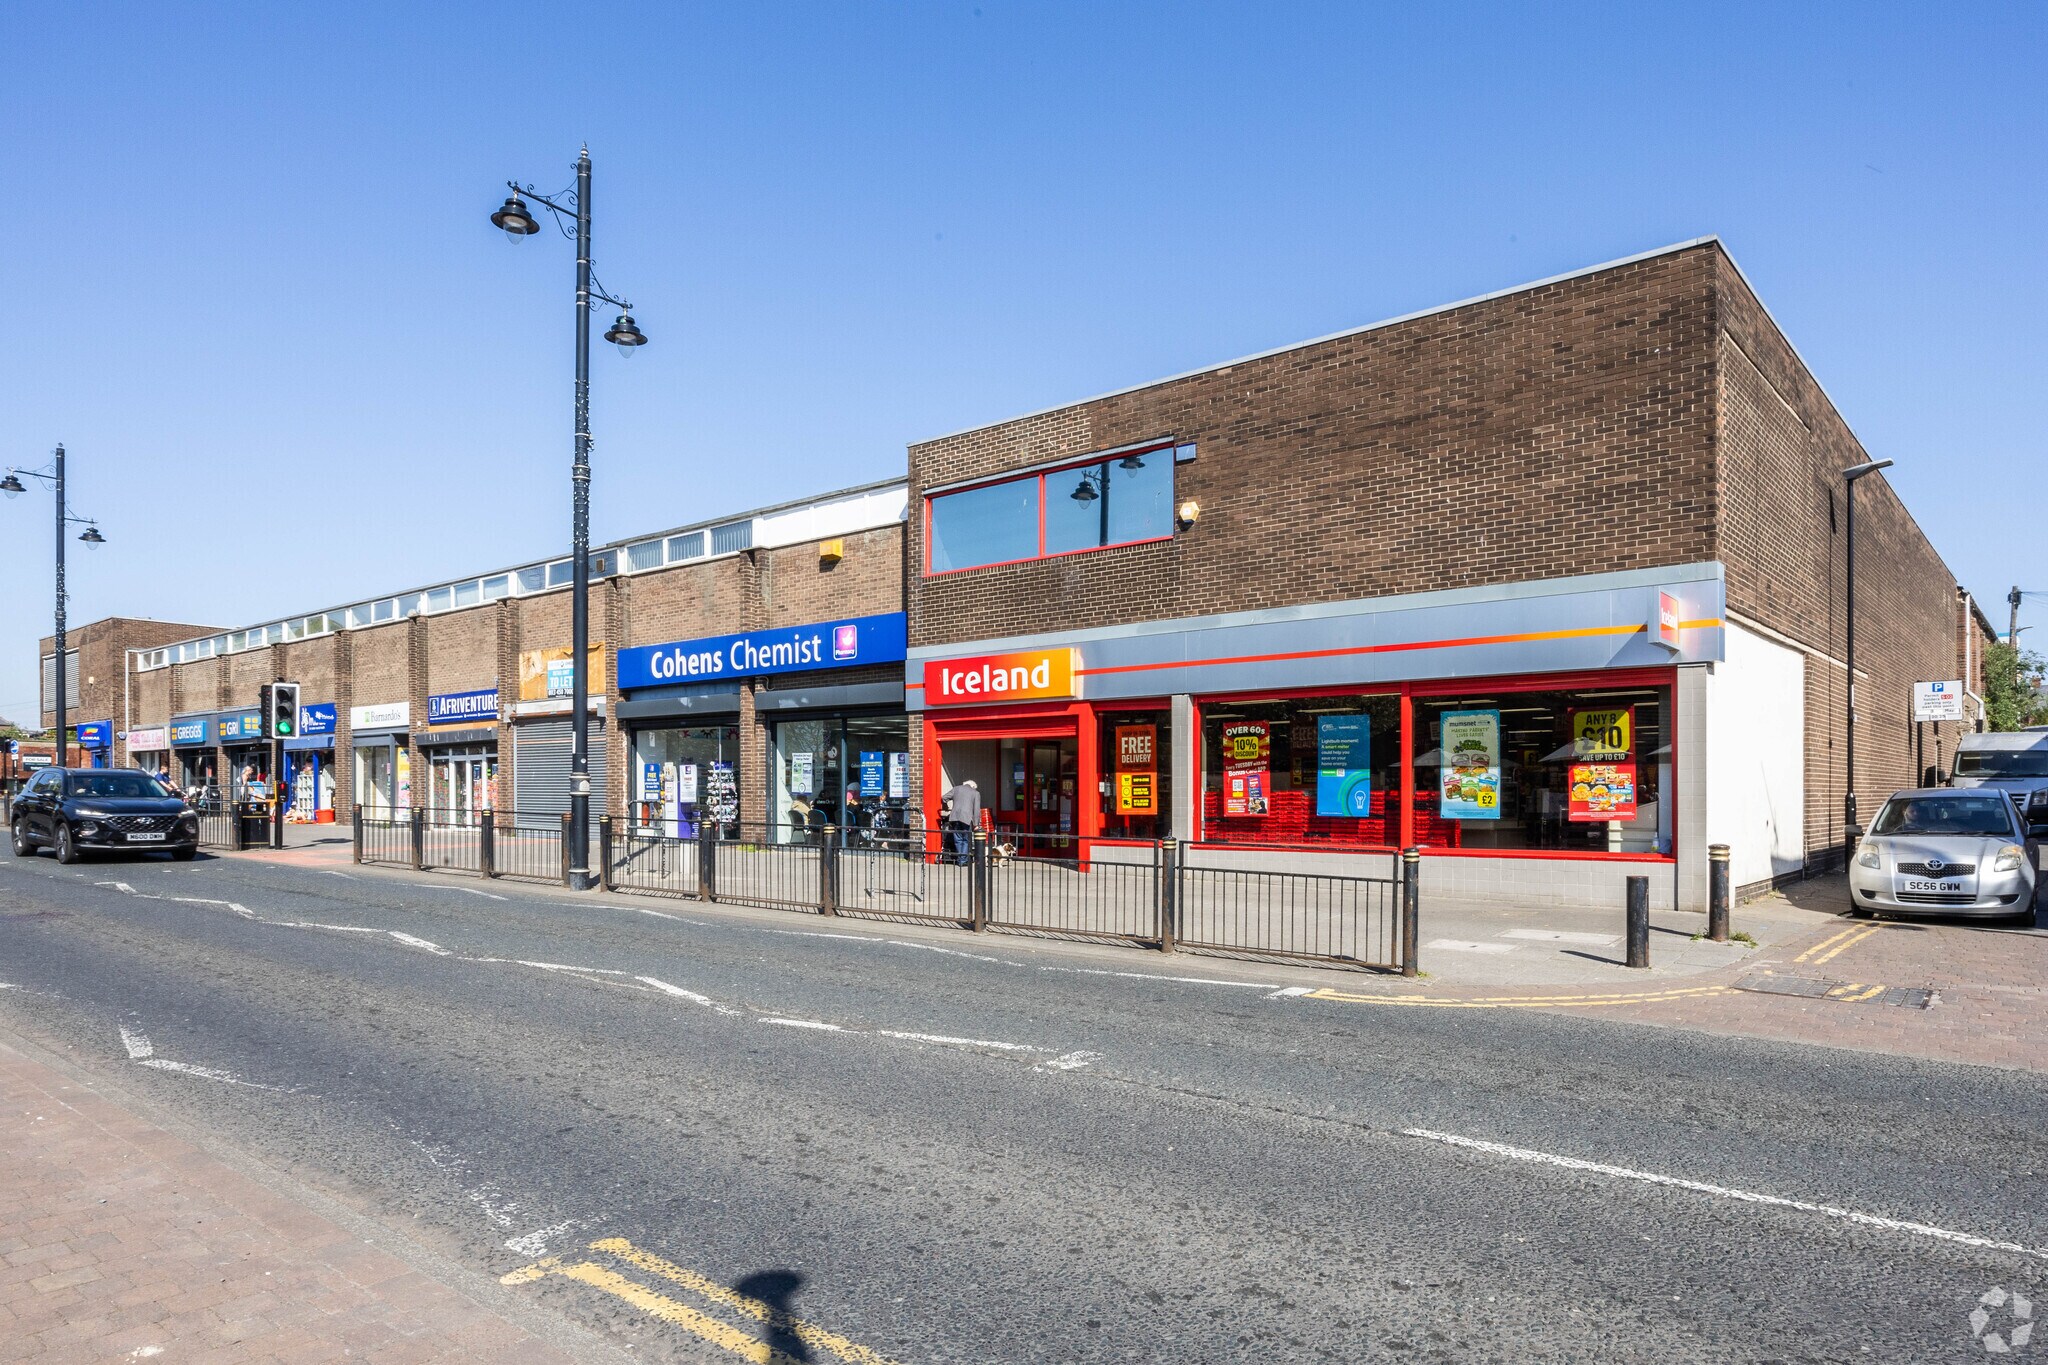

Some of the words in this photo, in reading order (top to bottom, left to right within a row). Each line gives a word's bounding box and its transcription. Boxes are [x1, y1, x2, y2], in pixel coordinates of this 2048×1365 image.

[651, 648, 723, 679] Cohens
[730, 634, 822, 670] Chemist
[550, 677, 559, 688] TO
[942, 659, 1050, 695] Iceland
[440, 694, 499, 715] AFRIVENTURE
[371, 709, 401, 723] Barnardo's
[1586, 714, 1608, 725] ANY
[1610, 713, 1617, 725] 8
[178, 725, 202, 740] GREGGS
[1226, 726, 1249, 736] OVER
[1249, 726, 1266, 735] 60s
[1581, 726, 1622, 750] £10
[1121, 736, 1151, 754] FREE
[1235, 739, 1257, 751] 10%
[1121, 754, 1151, 763] DELIVERY
[1579, 753, 1594, 761] SAVE
[1595, 753, 1603, 761] UP
[1614, 752, 1625, 760] £10
[1235, 761, 1253, 769] TUESDAY
[1228, 769, 1245, 777] Bonus
[1482, 796, 1492, 804] £2
[1940, 883, 1961, 891] GWM
